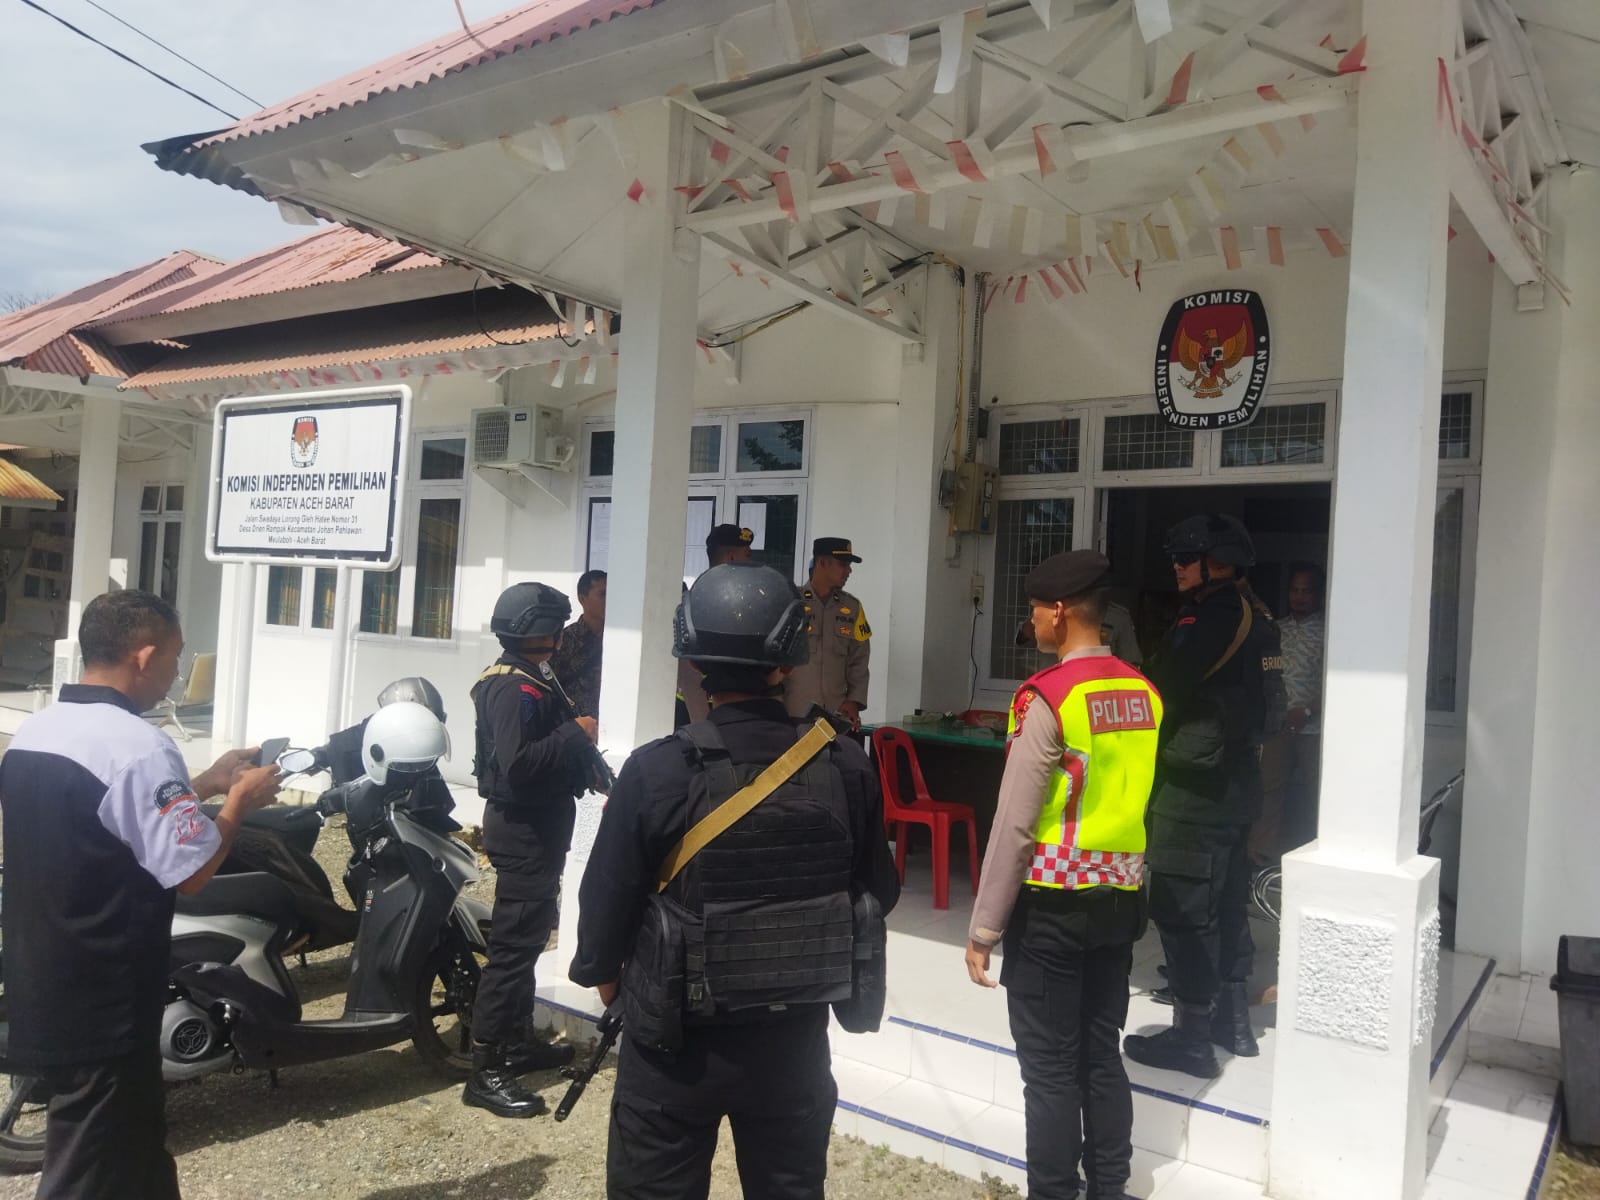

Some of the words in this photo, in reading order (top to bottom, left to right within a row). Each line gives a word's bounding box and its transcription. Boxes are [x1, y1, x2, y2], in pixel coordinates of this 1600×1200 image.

[1184, 291, 1250, 309] KOMISI
[1157, 359, 1209, 427] INDEPENDEN
[1218, 350, 1268, 425] PEMILIHAN
[227, 474, 260, 492] KOMISI
[262, 473, 325, 492] INDEPENDEN
[328, 471, 387, 491] PEMILIHAN
[250, 497, 298, 510] KABUPATEN
[299, 496, 323, 510] ACEH
[325, 496, 355, 510] BARAT
[311, 536, 326, 545] Barat
[1091, 697, 1150, 726] POLISI
